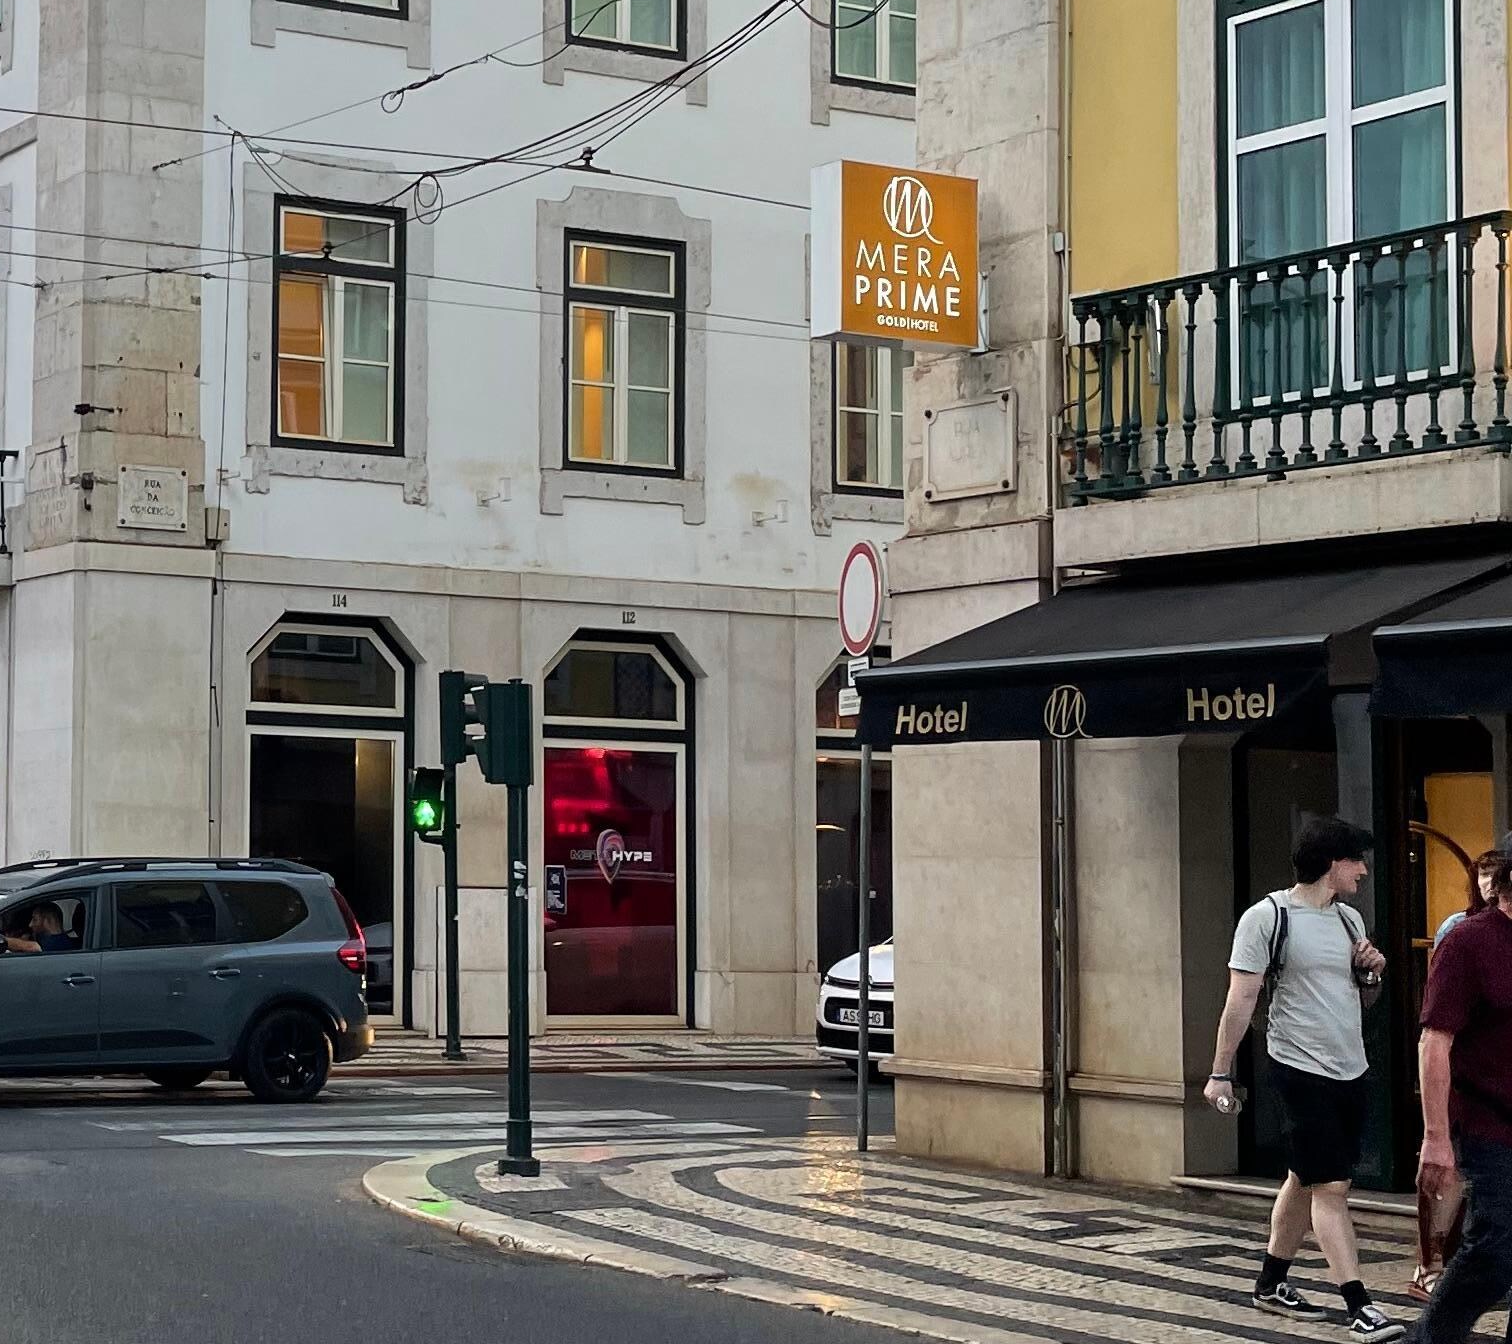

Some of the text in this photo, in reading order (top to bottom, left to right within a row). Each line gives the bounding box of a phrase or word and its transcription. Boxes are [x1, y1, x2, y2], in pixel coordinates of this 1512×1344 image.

[855, 239, 961, 282] MERA
[855, 274, 961, 317] PRIME
[144, 479, 161, 488] RUA
[147, 492, 159, 502] DA
[332, 593, 347, 607] 114
[622, 610, 636, 624] 112
[1186, 683, 1275, 721] Hotel
[895, 701, 968, 735] Hotel
[612, 850, 653, 862] HYPE
